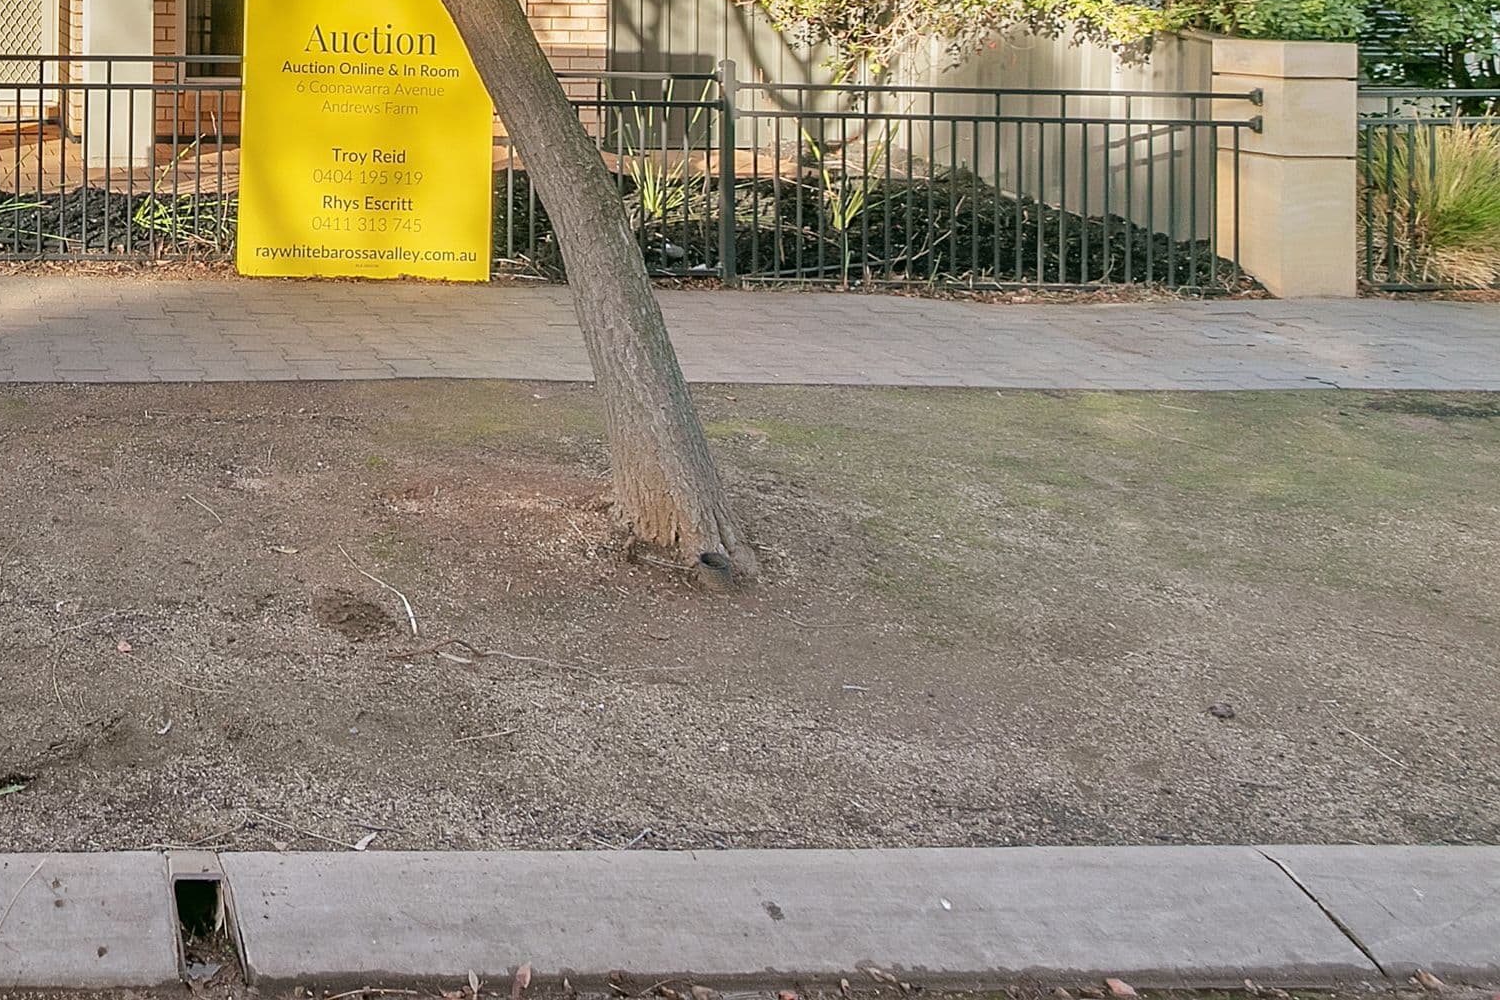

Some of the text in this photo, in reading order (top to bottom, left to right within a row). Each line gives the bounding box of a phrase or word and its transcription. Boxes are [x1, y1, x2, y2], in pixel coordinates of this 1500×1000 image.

[304, 24, 438, 56] Auction
[282, 61, 460, 78] Auction Online & In Room
[296, 81, 445, 97] 6 Coonawarra Avenue
[321, 101, 419, 115] Andrews Farm
[332, 148, 406, 165] Troy Reid
[313, 169, 423, 186] 0404 195 919
[323, 195, 413, 213] Rhys Escritt
[312, 217, 422, 233] 0411 313 745
[255, 244, 477, 263] raywhitebarossavalley.com.au
